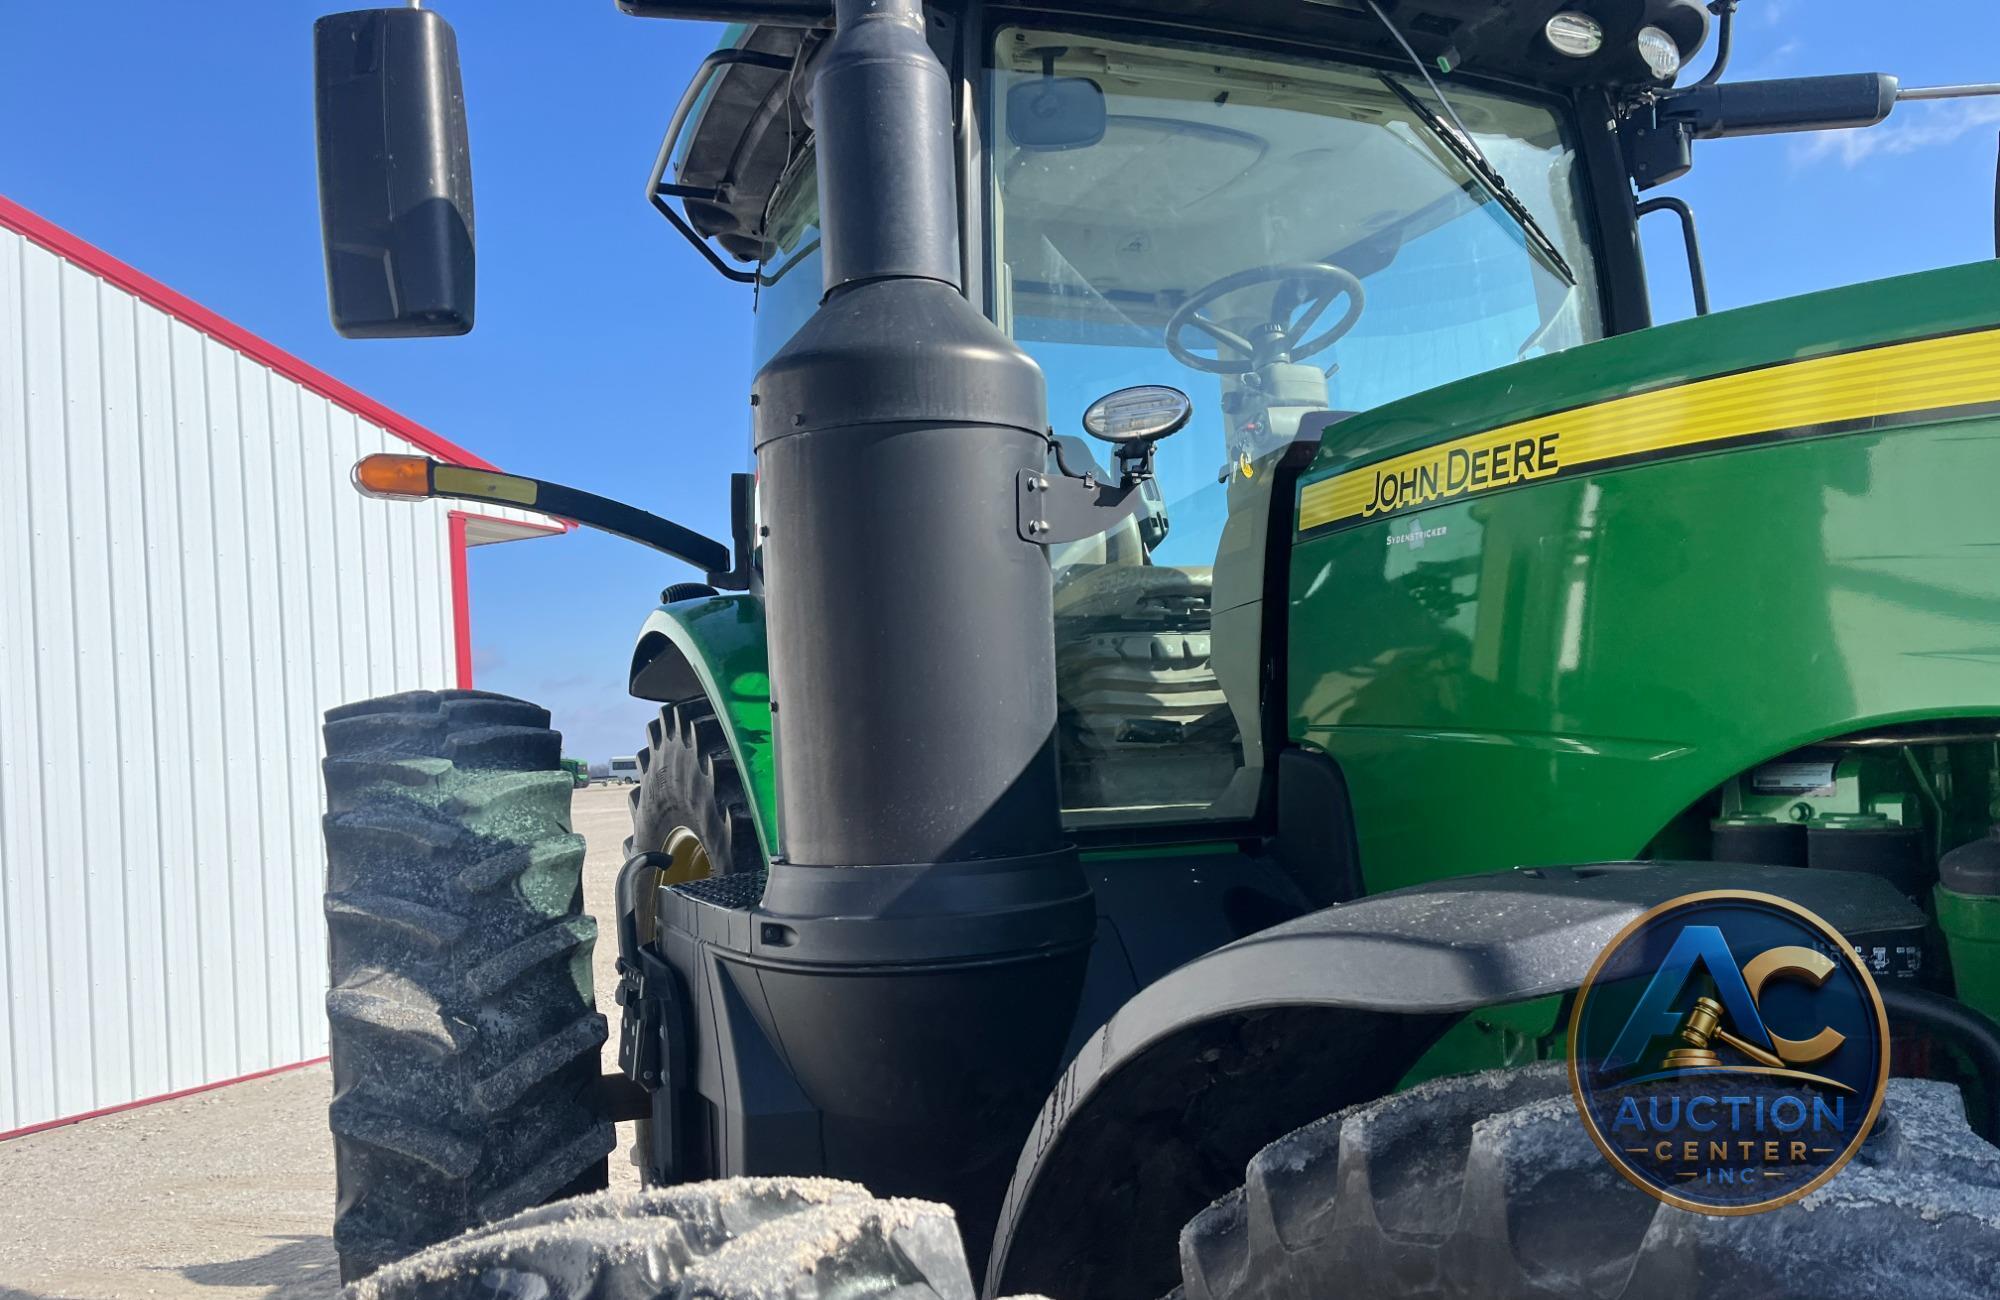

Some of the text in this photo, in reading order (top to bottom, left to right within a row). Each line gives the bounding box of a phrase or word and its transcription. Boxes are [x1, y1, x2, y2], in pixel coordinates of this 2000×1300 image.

[1364, 433, 1560, 513] JOHN DEERE
[1386, 526, 1447, 546] SYDENSTRICKER
